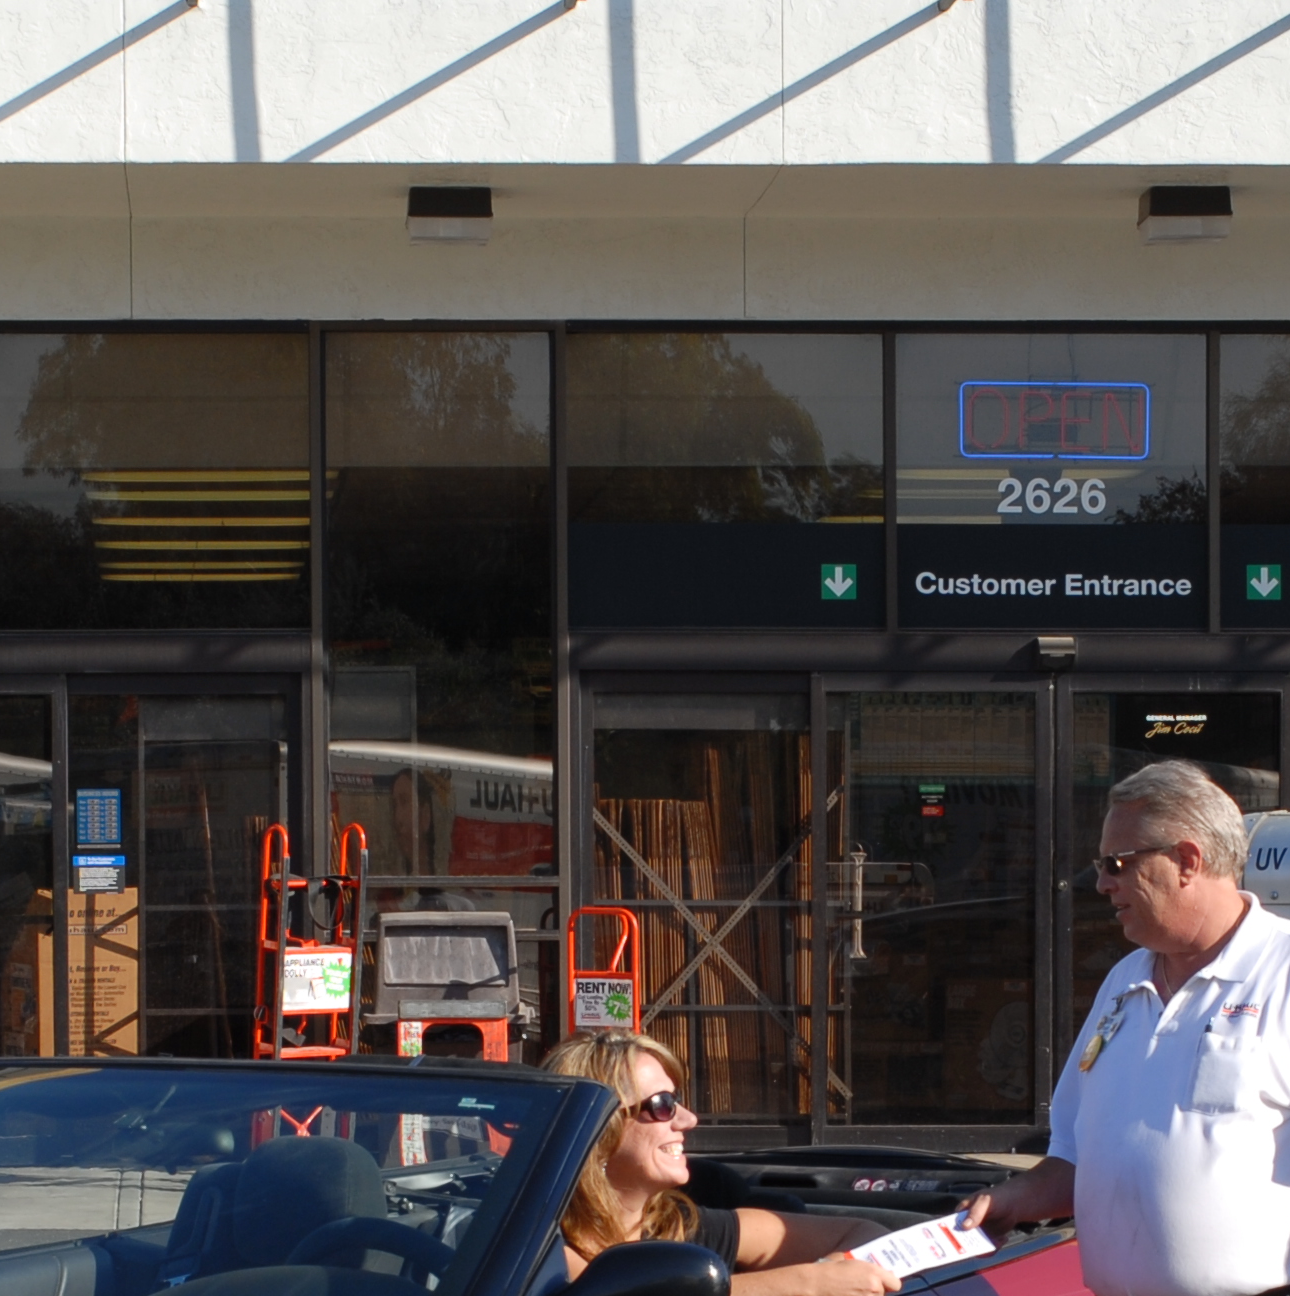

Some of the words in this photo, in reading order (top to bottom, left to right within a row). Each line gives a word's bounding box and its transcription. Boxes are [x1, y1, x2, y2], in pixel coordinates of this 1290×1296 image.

[967, 388, 1143, 452] OPEN
[997, 477, 1107, 515] 2626
[915, 571, 1057, 596] Customer
[1065, 574, 1192, 596] Entrance
[1255, 847, 1288, 871] UV
[284, 958, 325, 967] APPLIANCE
[284, 968, 307, 978] DOLLY
[577, 982, 606, 994] RENT
[608, 983, 632, 995] NOW!
